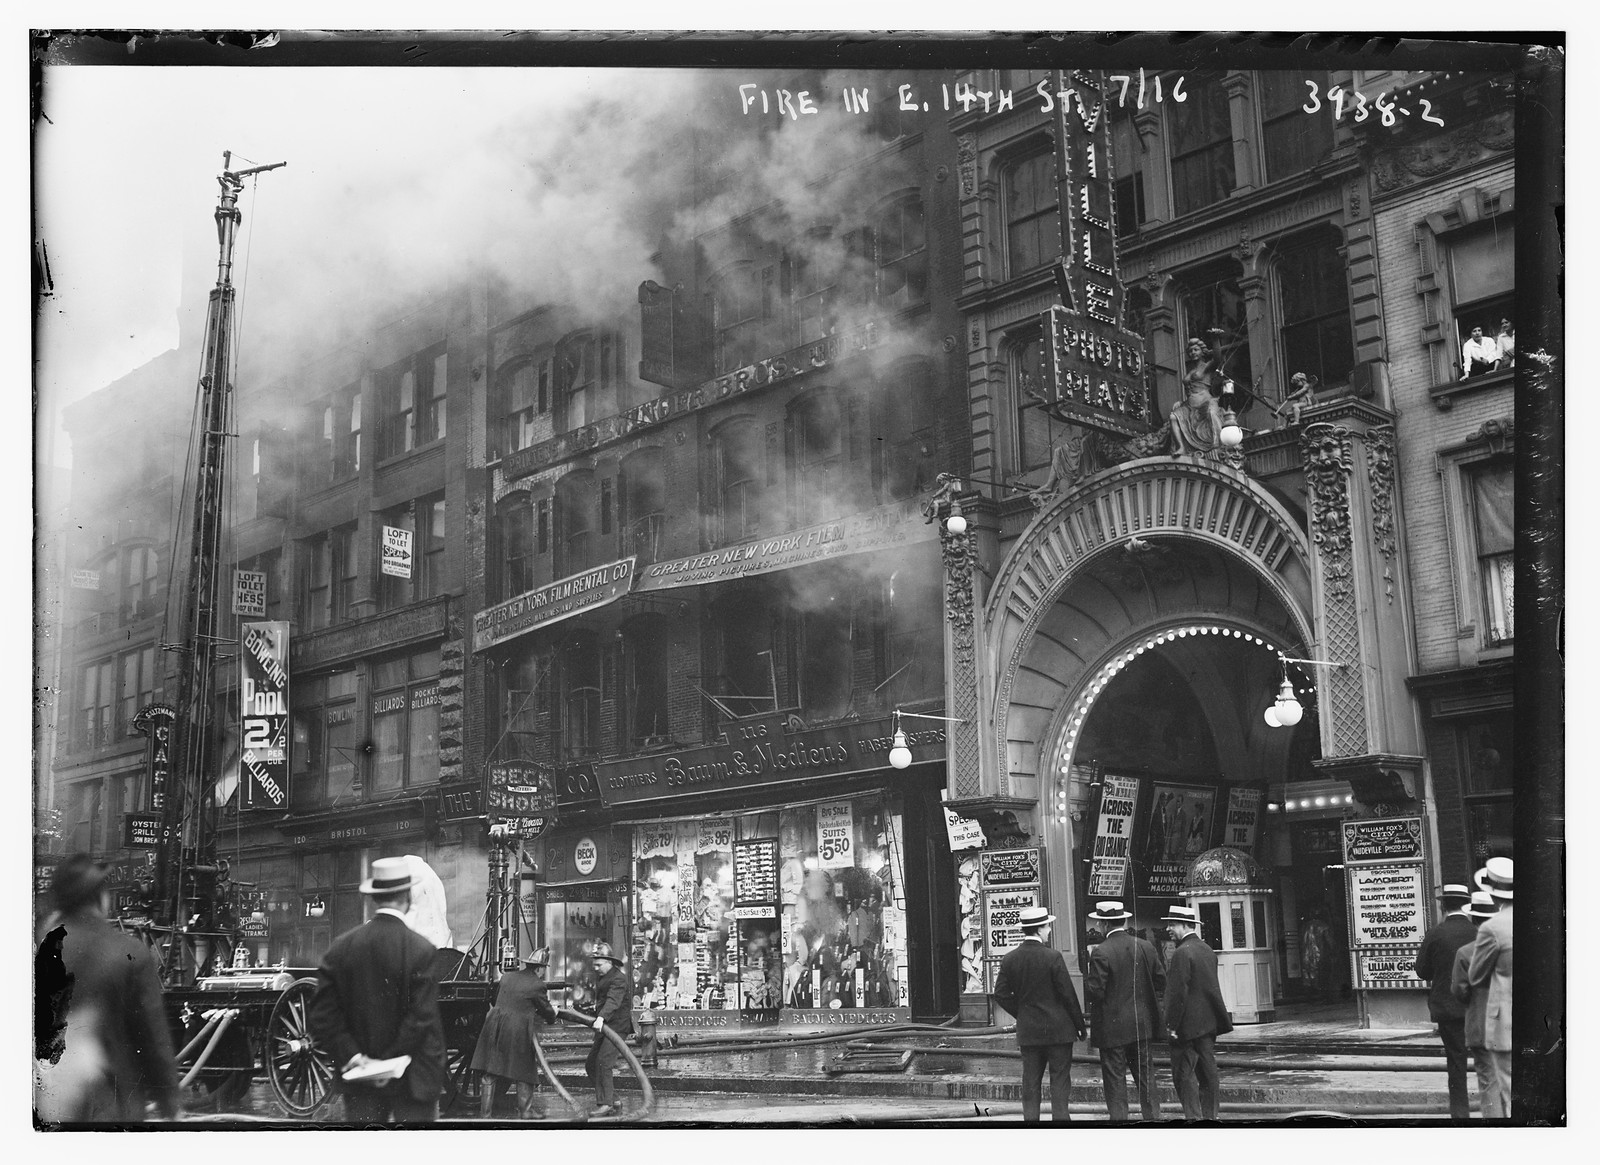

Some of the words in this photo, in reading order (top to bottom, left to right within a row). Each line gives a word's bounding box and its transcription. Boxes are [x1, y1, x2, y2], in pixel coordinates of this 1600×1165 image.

[1063, 324, 1142, 376] PHOTO
[1066, 368, 1146, 420] PLAYS
[388, 528, 408, 539] LOFT
[650, 554, 719, 577] GREATER
[721, 545, 758, 565] NEW
[761, 534, 803, 556] YORK
[806, 523, 846, 547] FILM
[238, 573, 263, 581] LOFT
[675, 571, 715, 583] MOVING
[238, 581, 247, 589] TO
[249, 582, 264, 591] LET
[238, 592, 263, 606] HESS
[476, 607, 507, 633] GREATER
[509, 600, 524, 619] NEW
[526, 590, 548, 612] YORK
[551, 583, 571, 602] FILM
[573, 569, 609, 595] RENTAL
[613, 563, 629, 581] CO.
[245, 629, 287, 688] BOWLING
[243, 678, 287, 716] POOL
[415, 686, 440, 698] POCKET
[374, 696, 405, 714] BILLIARDS
[411, 695, 441, 709] BILLIARDS
[153, 726, 169, 808] CAFE
[268, 757, 283, 765] CUE
[242, 748, 285, 805] BILLIARDS
[492, 768, 552, 789] BECK
[609, 771, 658, 789] CLOTHIERS
[445, 791, 472, 813] THE
[489, 790, 556, 811] SHOES
[822, 807, 832, 817] BIG
[833, 806, 848, 816] SALE
[1101, 799, 1133, 816] ACROSS
[1228, 810, 1255, 825] ACROSS
[132, 828, 155, 836] GRILL
[294, 836, 306, 844] 120
[331, 827, 367, 839] BRISTOL
[396, 821, 410, 830] 120
[1107, 818, 1124, 834] THE
[822, 828, 846, 838] SUITS
[953, 834, 965, 842] THIS
[966, 831, 980, 839] CASE
[1233, 828, 1248, 843] THE
[577, 848, 594, 860] BECK
[1353, 846, 1382, 855] VAUDEVILLE
[1385, 845, 1401, 853] PHOTO
[1402, 843, 1414, 851] PLAY
[1152, 865, 1178, 873] LILLIAN
[1160, 876, 1186, 884] INNOCE
[1359, 876, 1414, 884] LAMBERTI
[991, 911, 1020, 919] ACROSS
[1376, 916, 1408, 924] GORDON
[1005, 918, 1019, 926] GRA
[991, 930, 1007, 947] SEE
[1368, 963, 1395, 971] LILLIAN
[1397, 962, 1416, 971] GISH
[680, 1016, 726, 1026] MEDICUS
[792, 1013, 824, 1024] BAUM
[829, 1013, 835, 1024] &
[839, 1012, 896, 1024] MEDICUS
